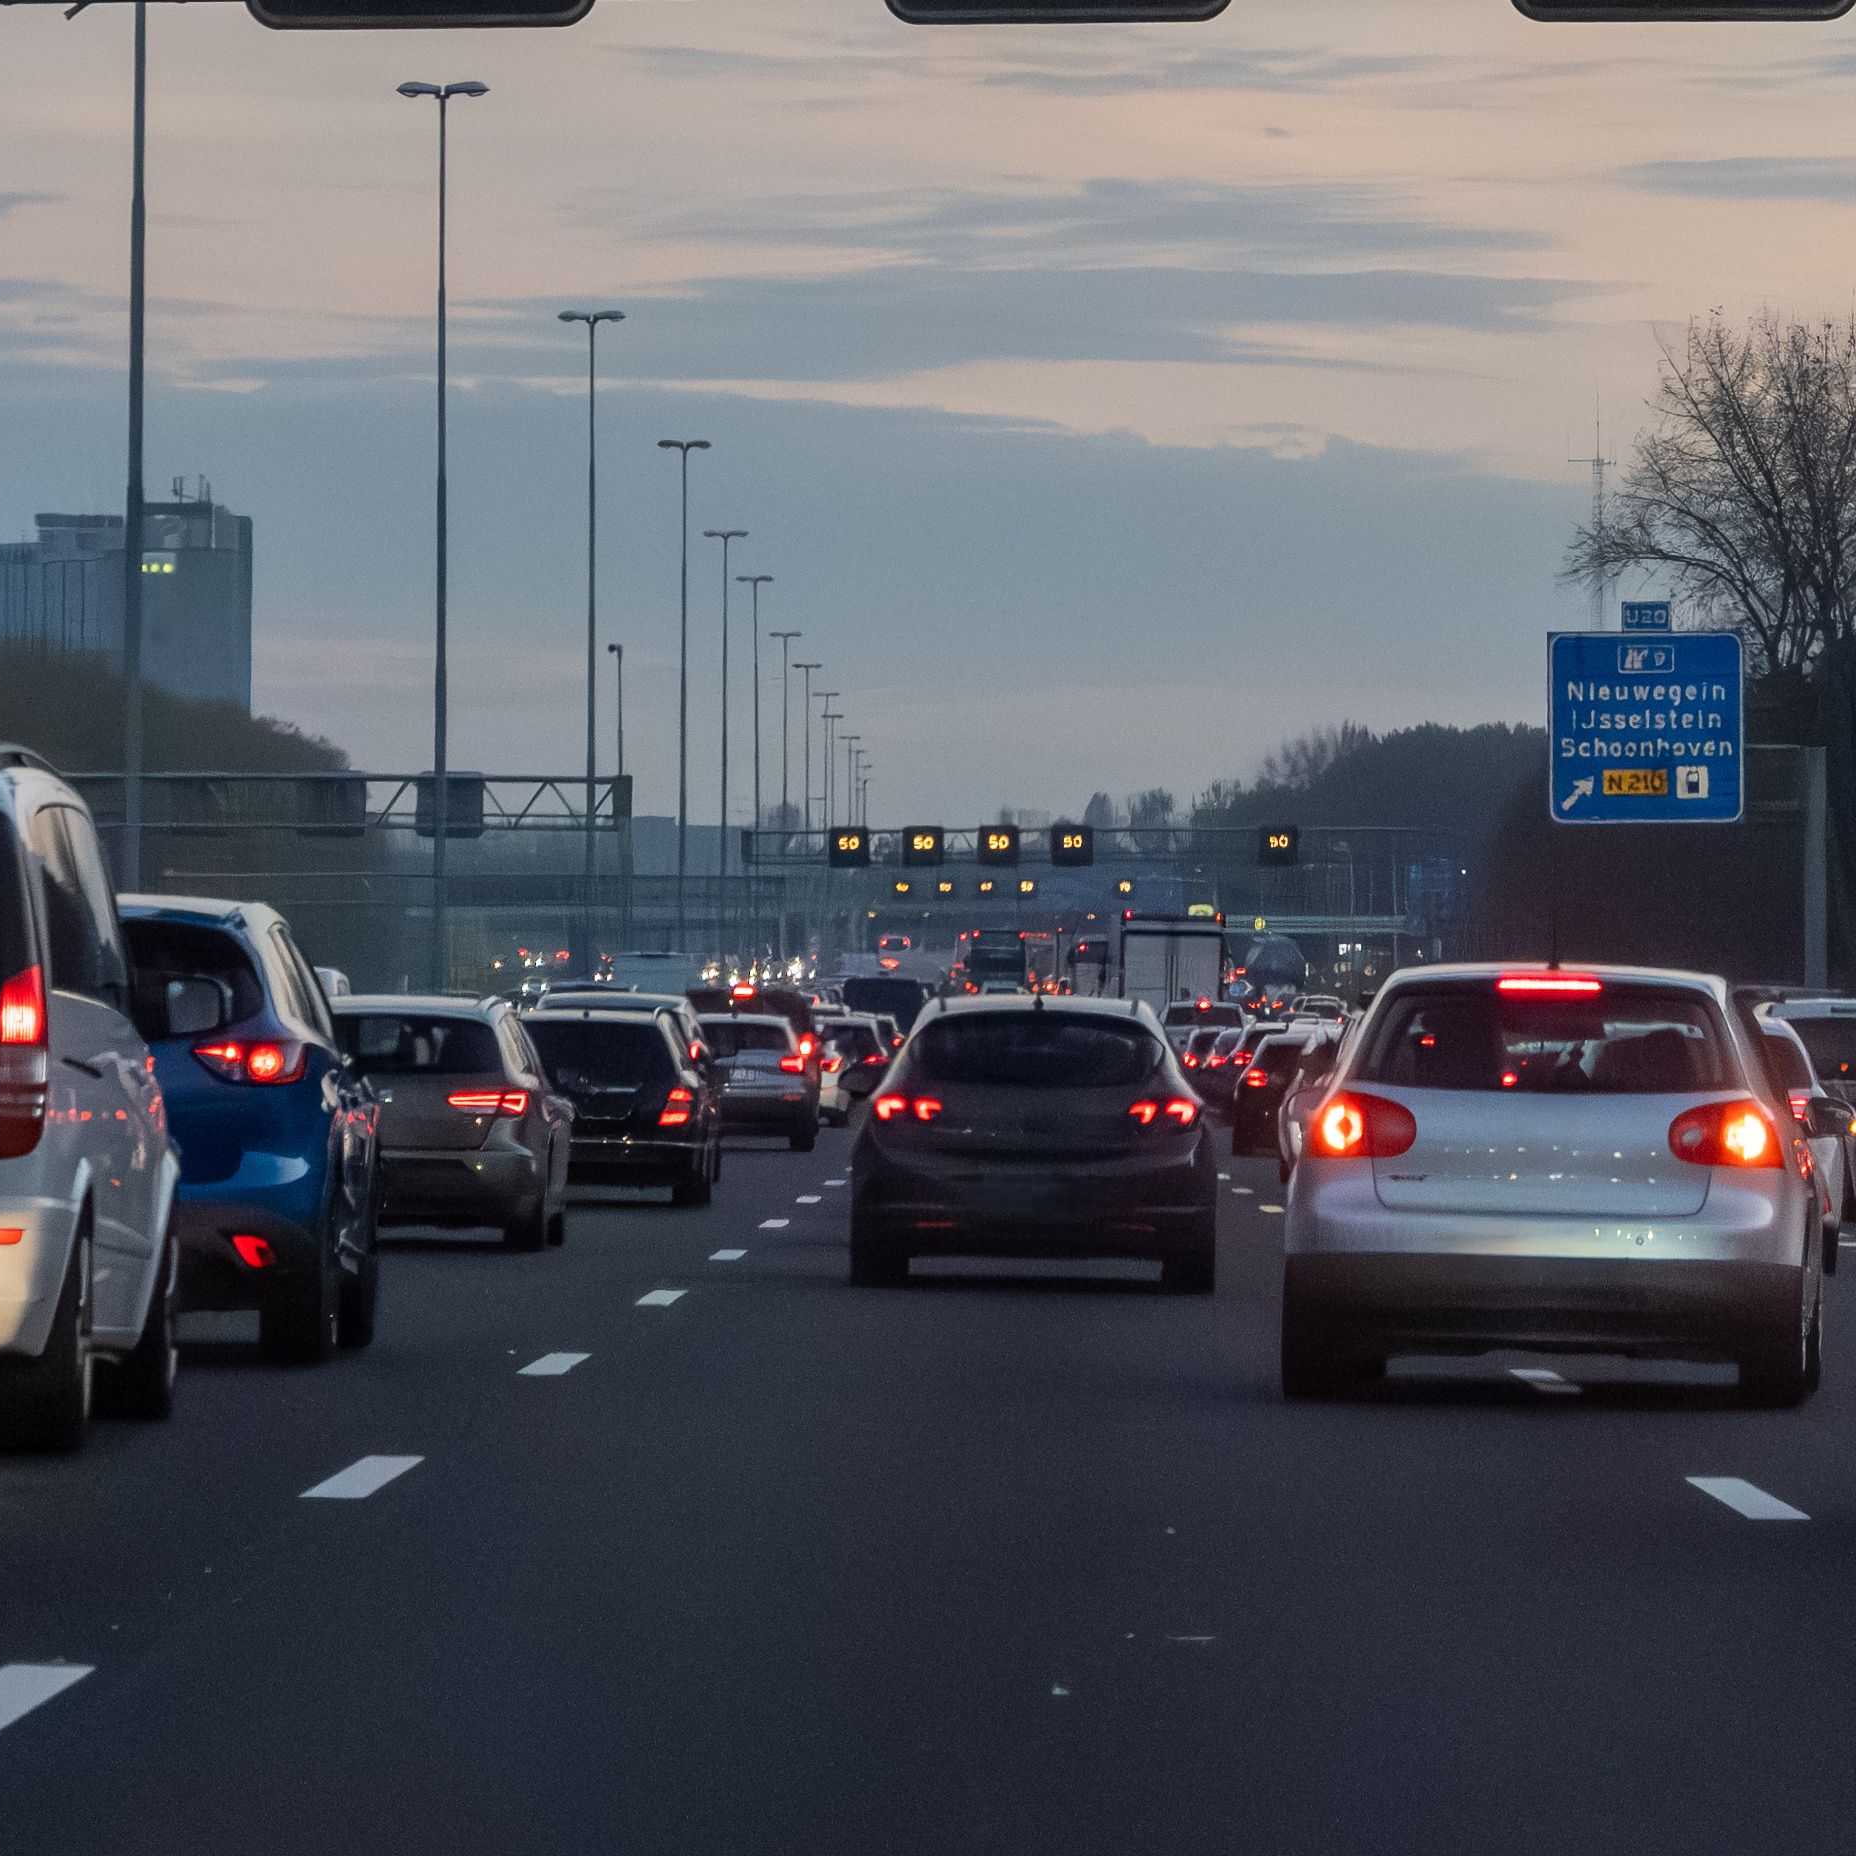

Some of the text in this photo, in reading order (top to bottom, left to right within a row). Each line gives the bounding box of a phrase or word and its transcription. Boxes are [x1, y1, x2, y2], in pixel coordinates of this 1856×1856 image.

[1567, 681, 1726, 706] Nieuwegein
[1560, 737, 1733, 758] Schoonhoven
[838, 835, 860, 851] 50
[913, 834, 935, 851] 50
[988, 833, 1010, 851] 50
[1062, 834, 1083, 849] 50
